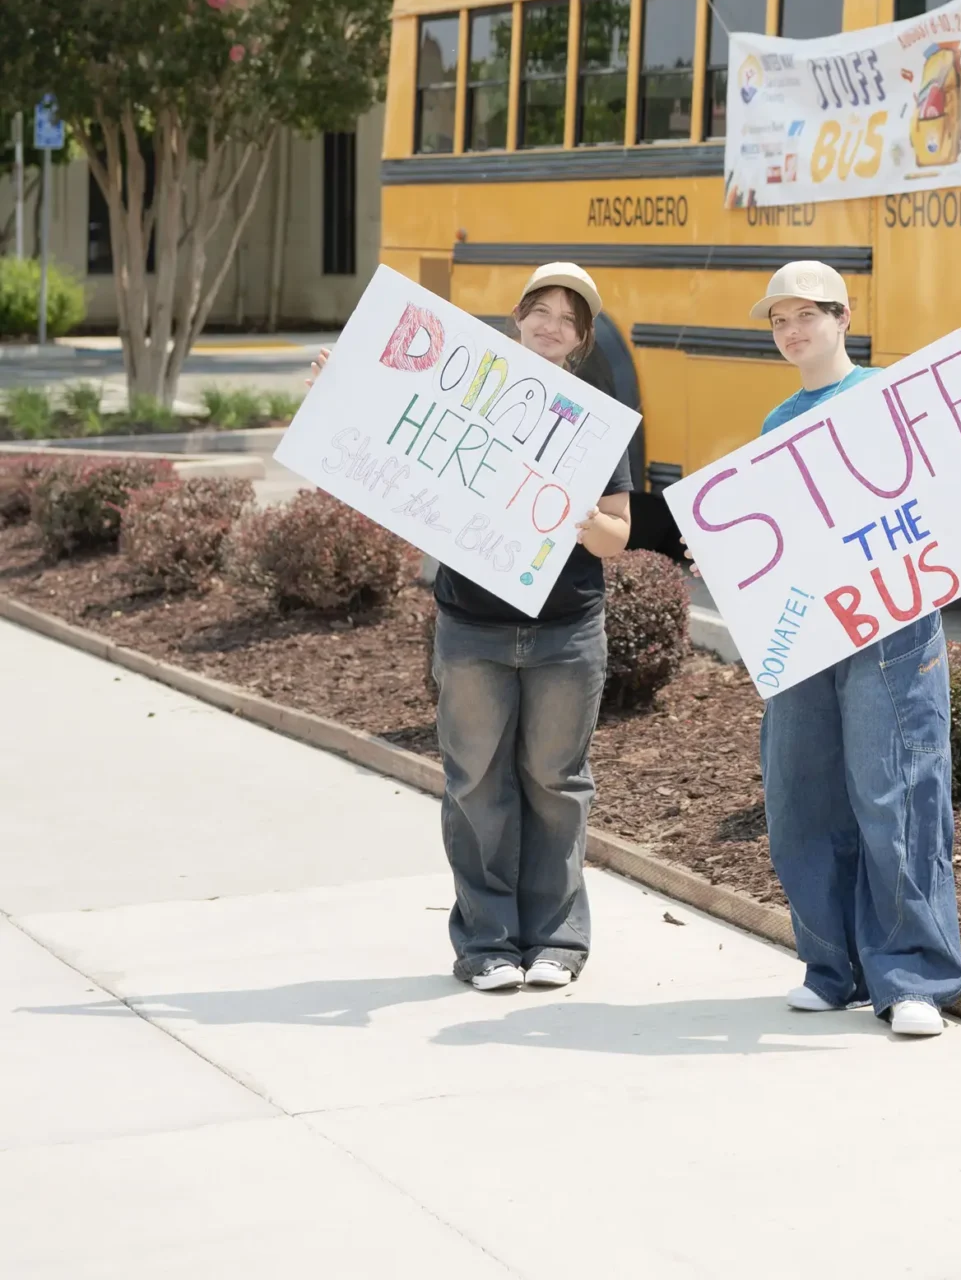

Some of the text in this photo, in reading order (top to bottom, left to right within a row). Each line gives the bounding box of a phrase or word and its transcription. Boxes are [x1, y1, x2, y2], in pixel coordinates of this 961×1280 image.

[807, 48, 886, 110] STUFF
[810, 110, 888, 184] BUS
[588, 195, 688, 227] ATASCADERO
[747, 202, 815, 227] UNIFIED
[387, 393, 571, 533] HERE TO
[391, 488, 451, 534] the
[842, 498, 931, 561] THE
[824, 540, 960, 648] BUS
[757, 585, 815, 689] DONATE!
